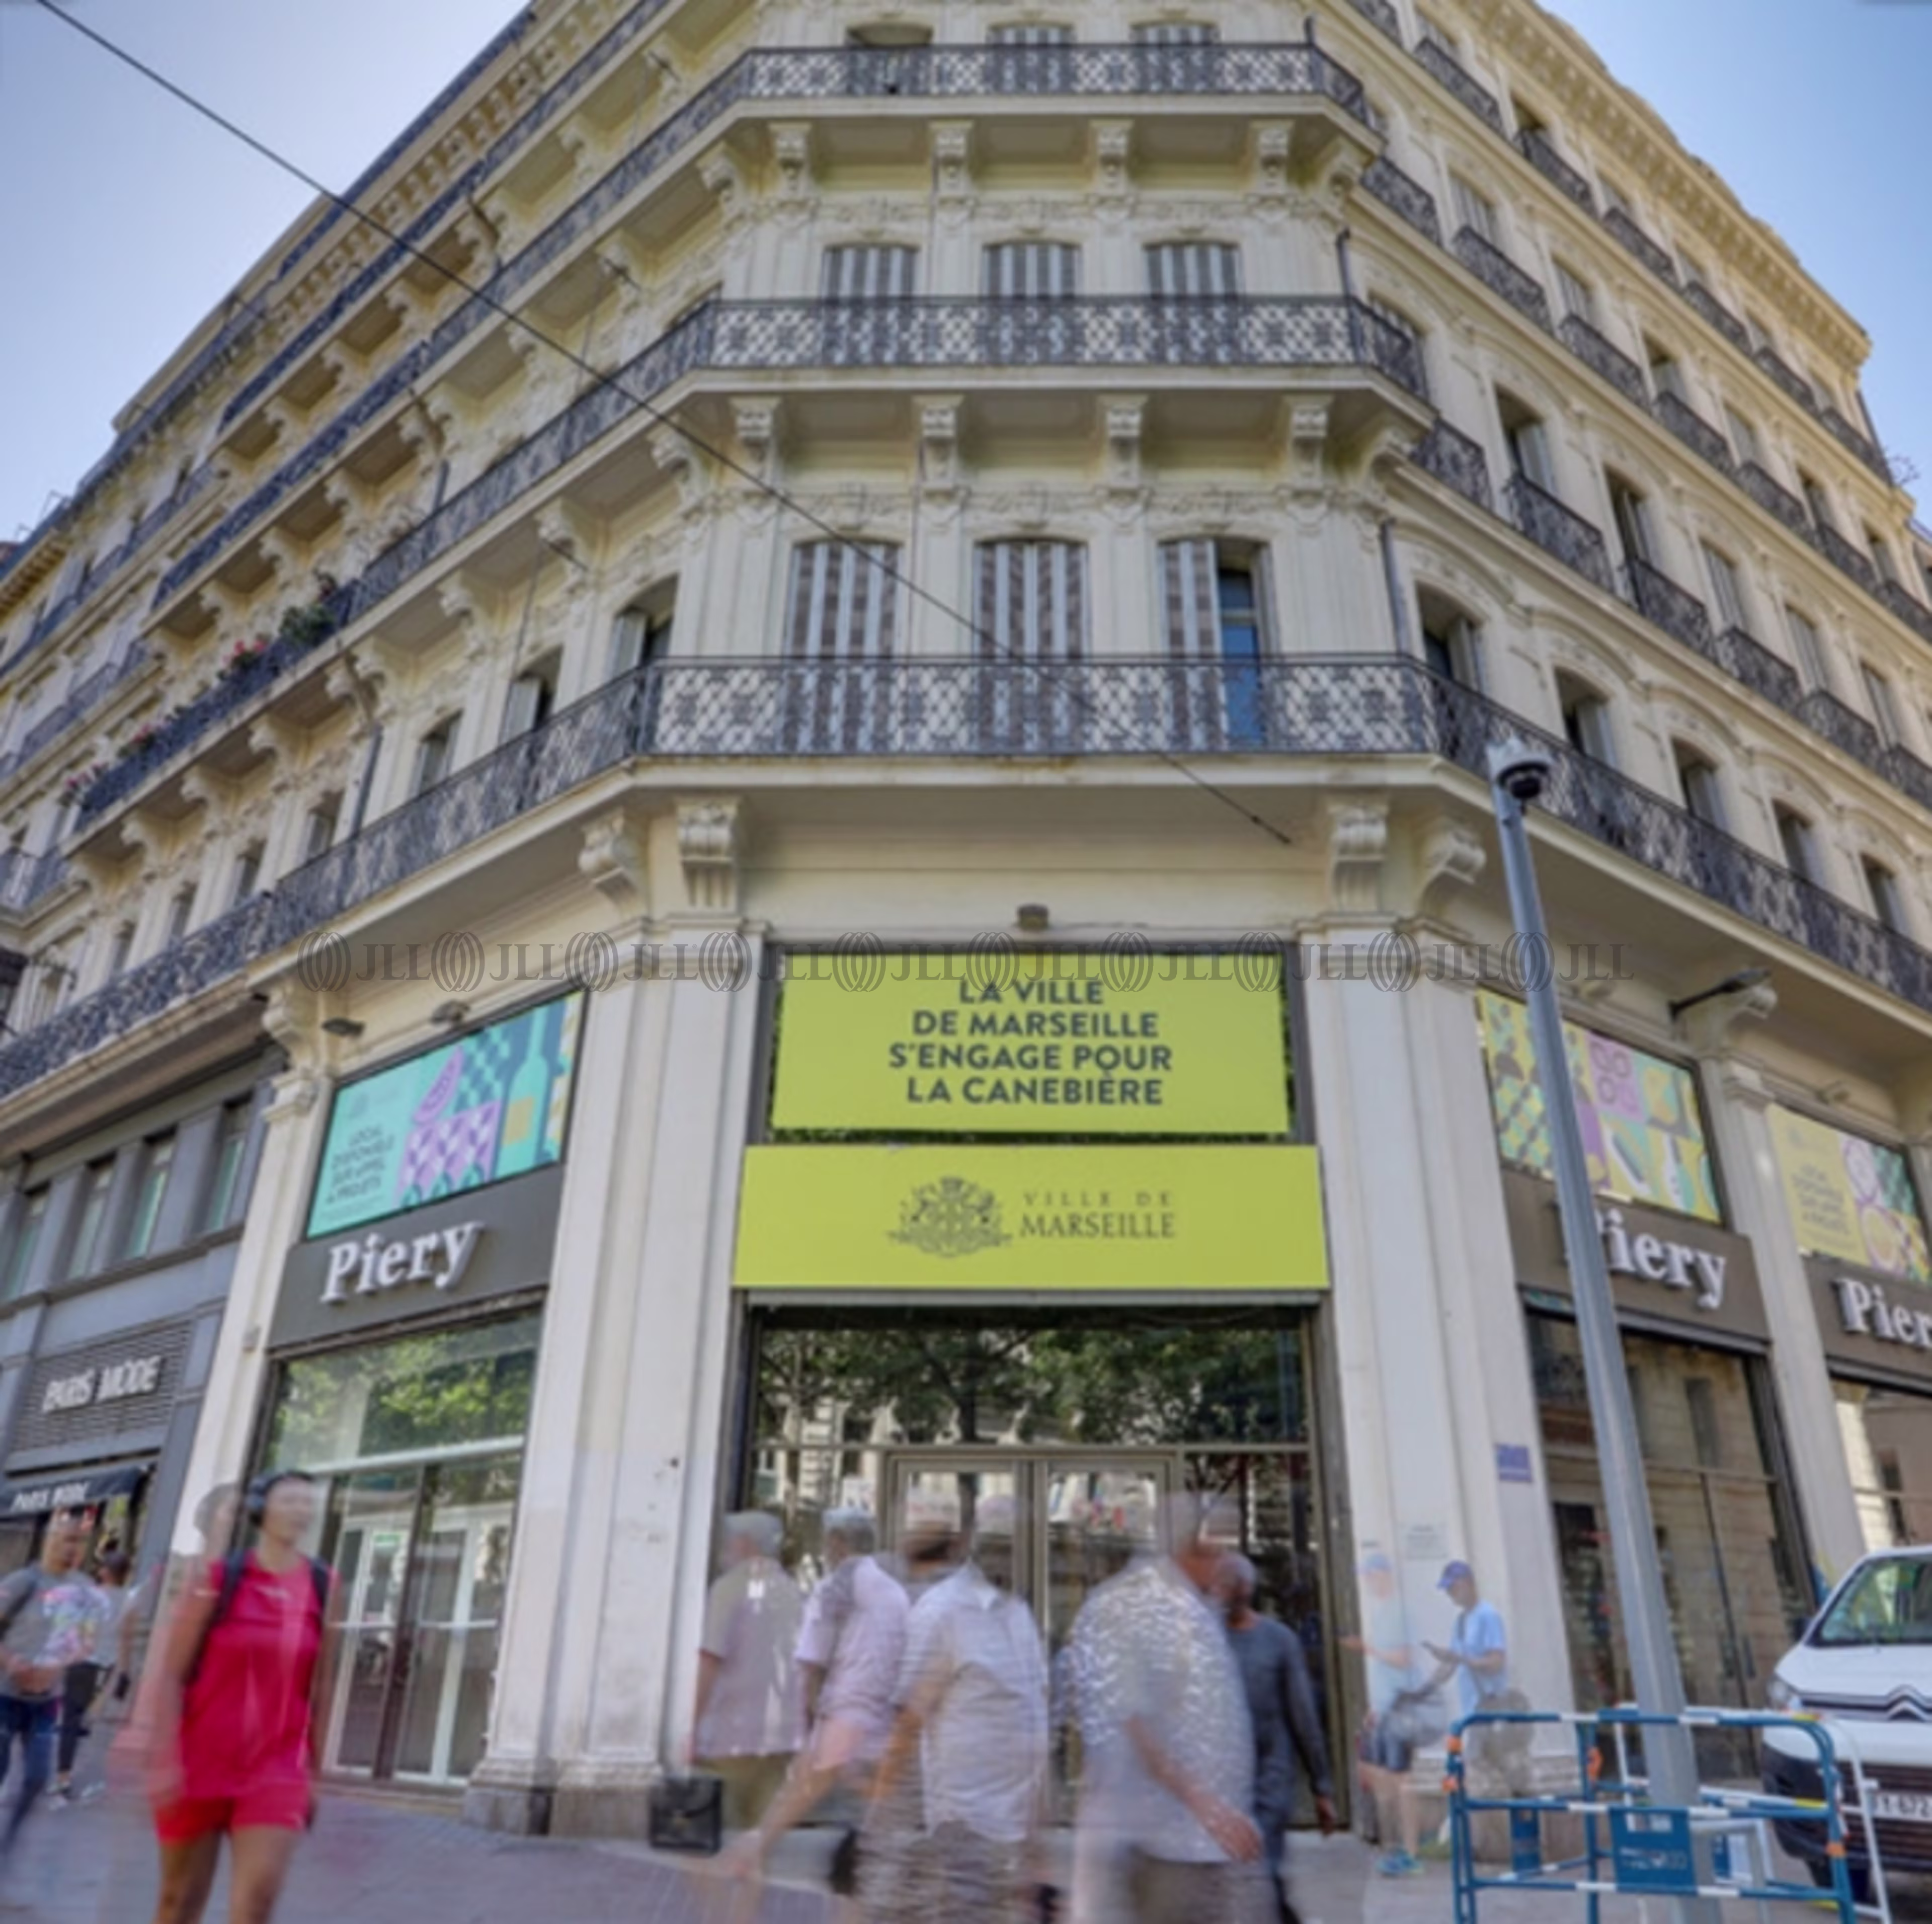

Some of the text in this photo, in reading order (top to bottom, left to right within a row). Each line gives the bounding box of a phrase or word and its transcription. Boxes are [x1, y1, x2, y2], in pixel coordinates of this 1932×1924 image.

[958, 979, 1105, 1005] LA VILLE
[912, 1010, 1159, 1038] DE MARSEILLE
[889, 1042, 1172, 1071] S'ENGAGE POUR
[907, 1070, 1163, 1105] LA CANEBIÈRE
[1023, 1191, 1172, 1207] VILLE DE
[1019, 1213, 1175, 1238] MARSEILLE
[319, 1221, 484, 1303] Piery
